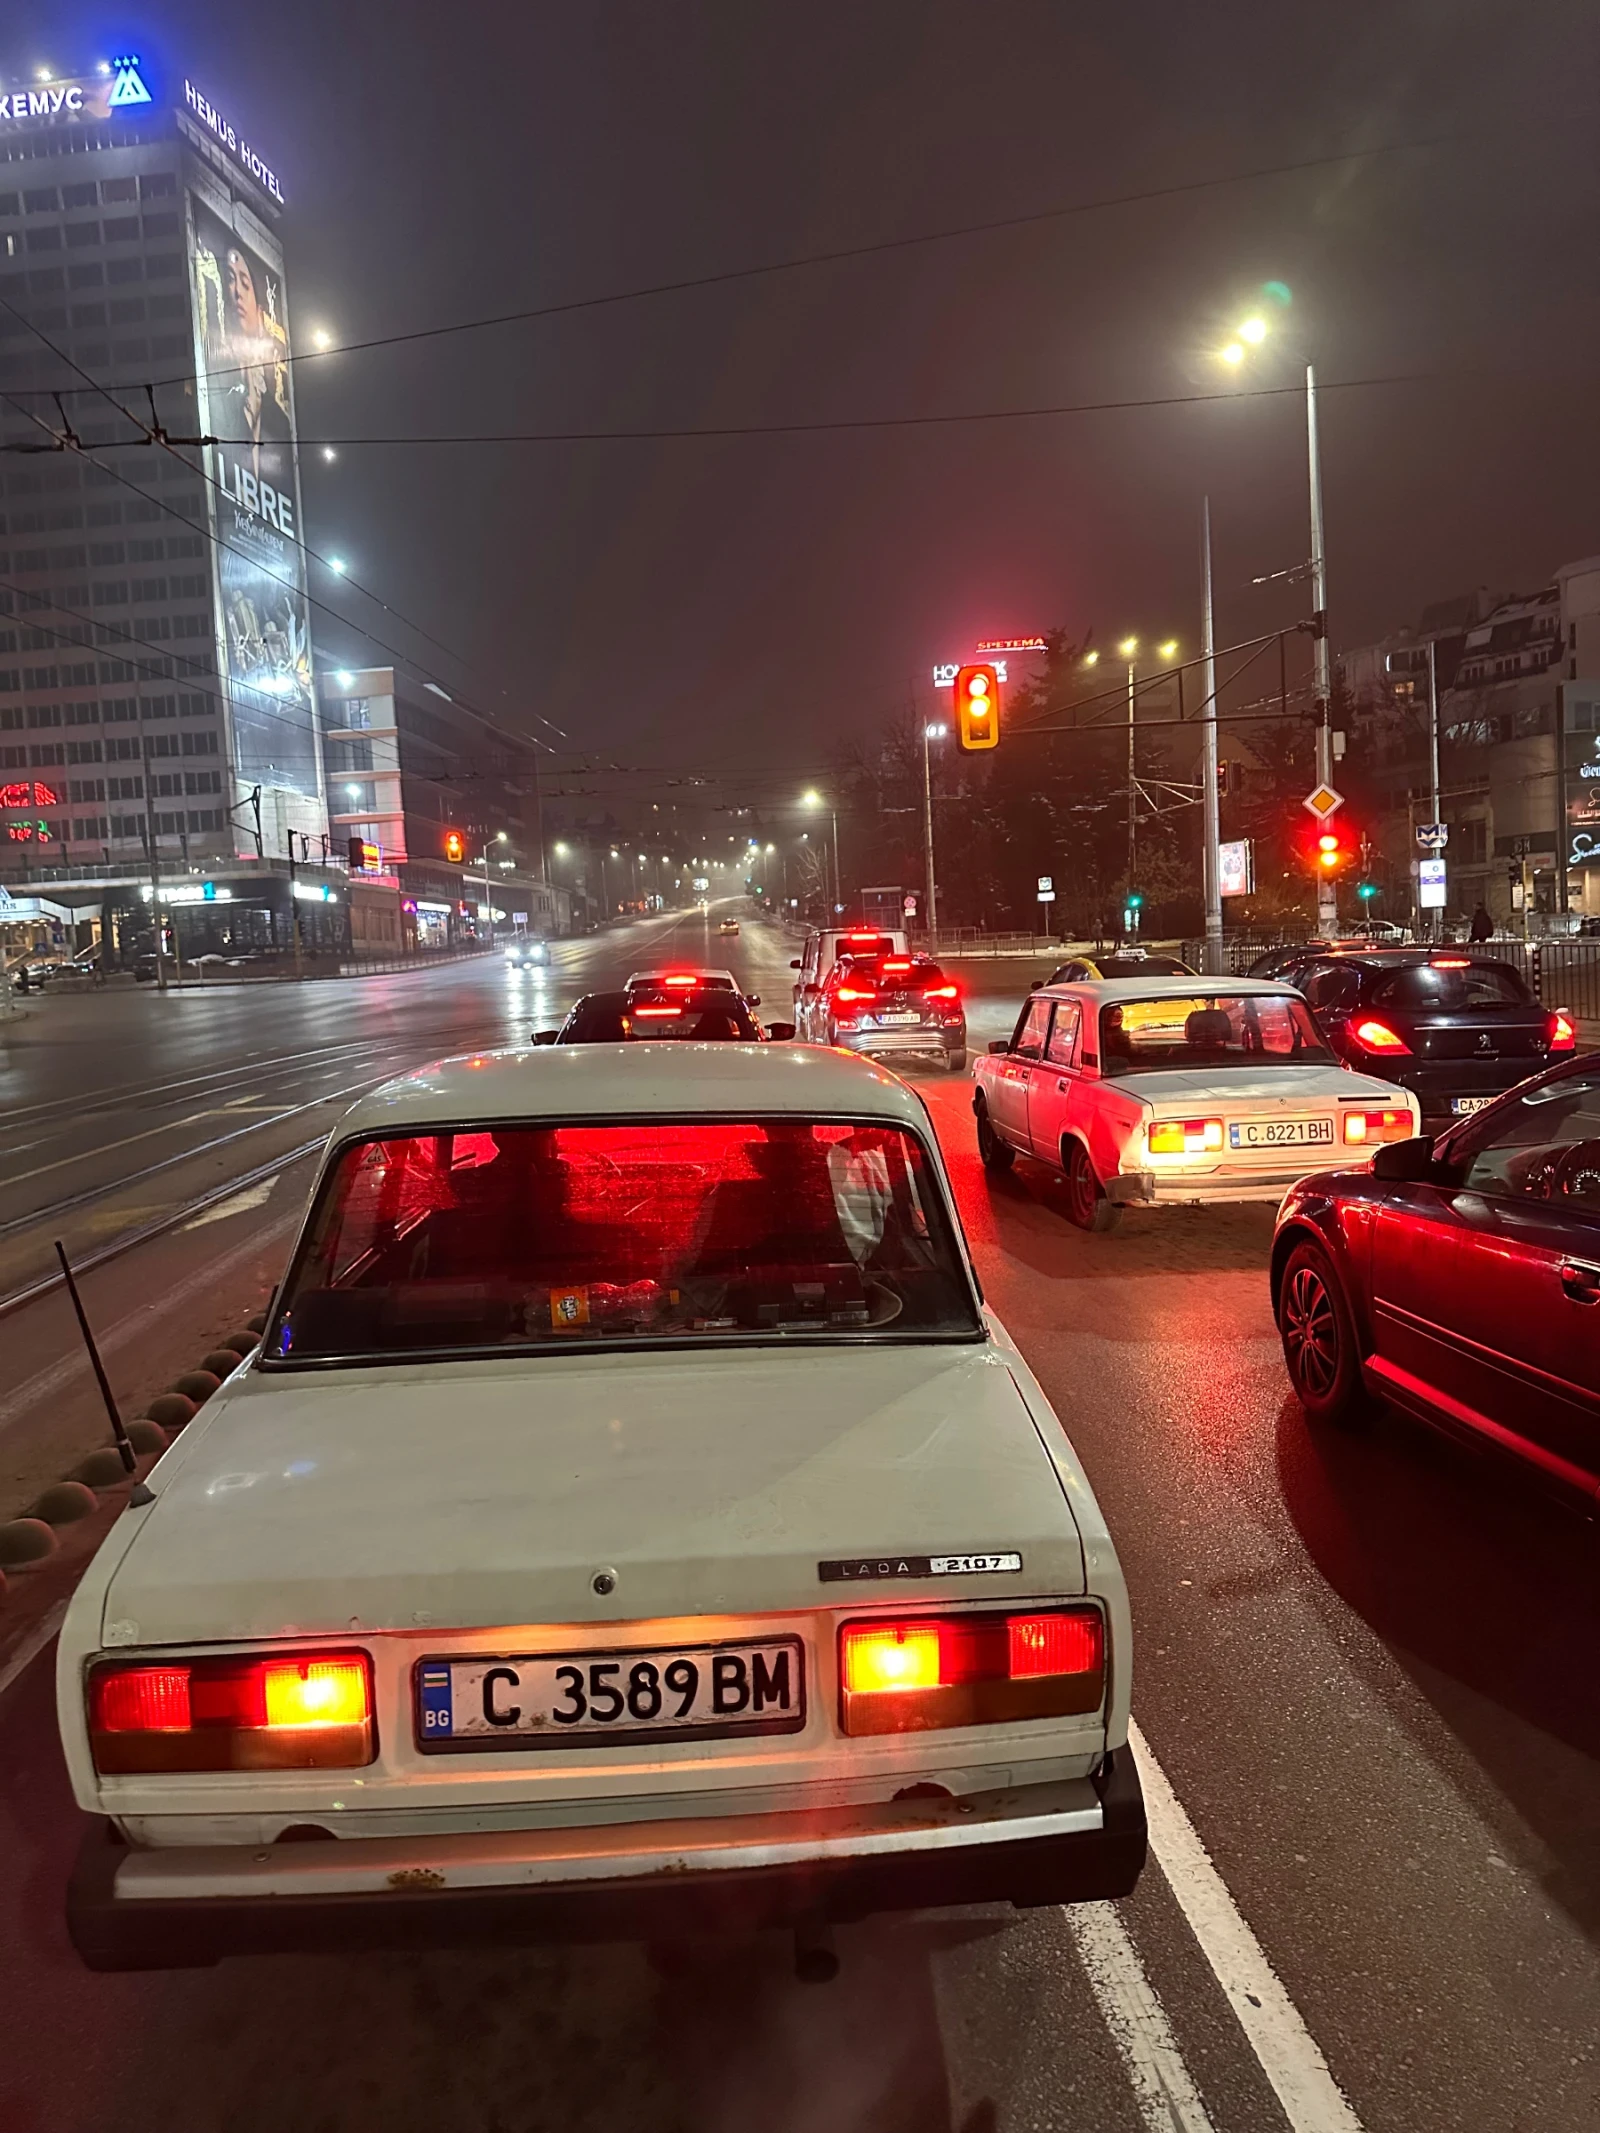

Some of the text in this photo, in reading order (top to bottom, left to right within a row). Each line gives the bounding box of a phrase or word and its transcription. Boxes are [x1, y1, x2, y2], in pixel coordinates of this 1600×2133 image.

[185, 79, 284, 204] HEMUS HOTEL
[218, 452, 295, 539] LIBRE
[977, 638, 1044, 650] SPETEMA
[947, 1558, 1002, 1570] 2107
[425, 1709, 449, 1728] BG
